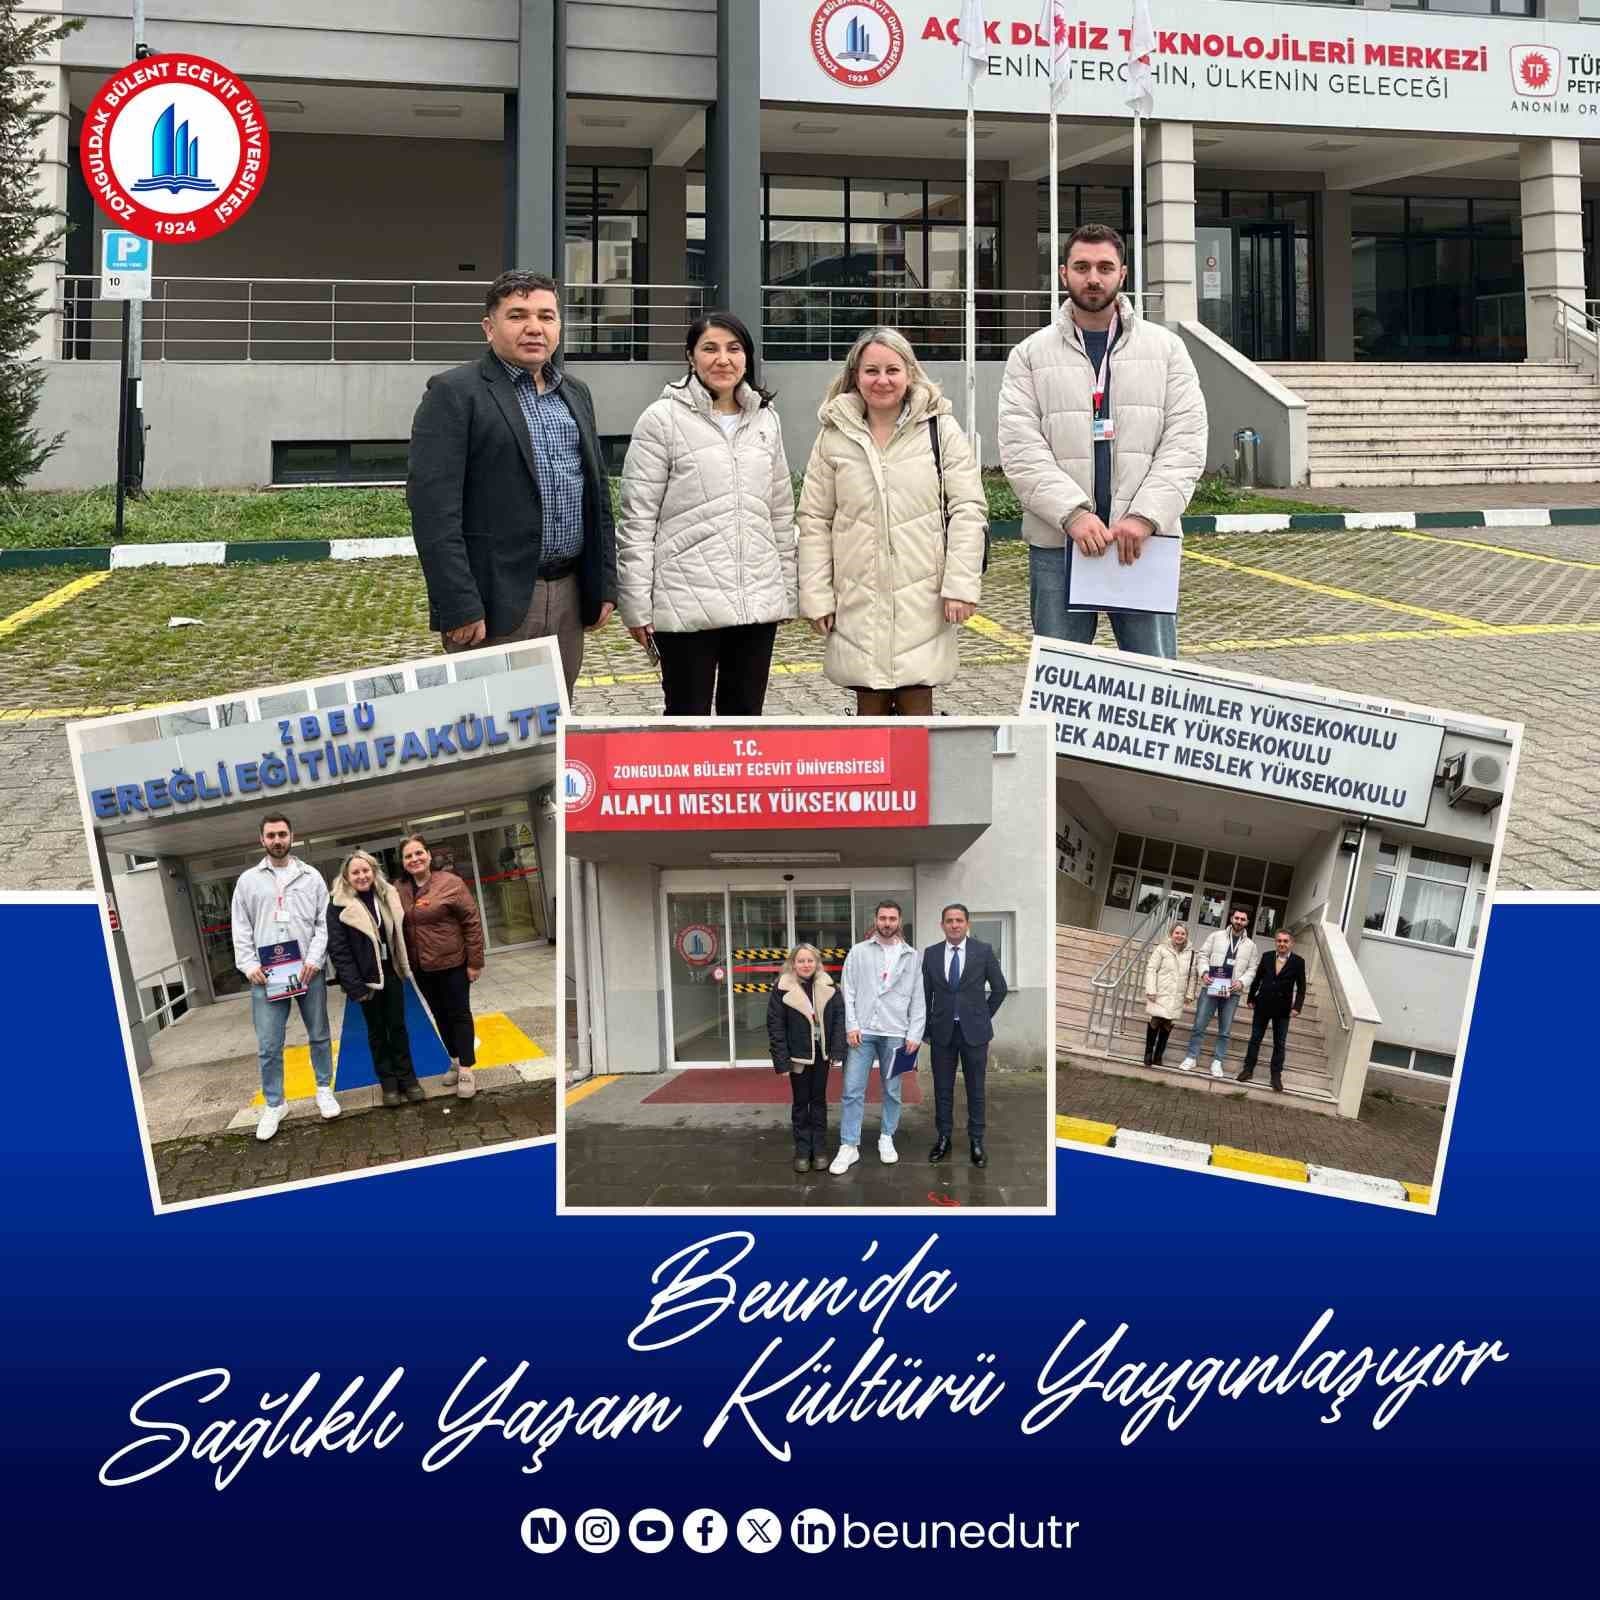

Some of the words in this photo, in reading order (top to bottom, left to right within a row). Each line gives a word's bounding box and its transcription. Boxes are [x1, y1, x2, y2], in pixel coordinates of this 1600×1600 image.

[920, 16, 1001, 46] AÇK
[1118, 29, 1355, 64] TKNOLOJİLERİ
[1364, 43, 1488, 72] MERKEZİ
[987, 53, 1051, 78] ENİN
[1206, 63, 1318, 92] ÜLKENİN
[1328, 73, 1448, 99] GELECEĞİ
[1510, 99, 1569, 113] ANONİM
[117, 237, 141, 262] P
[109, 277, 121, 287] 10
[1098, 703, 1179, 736] MESLEK
[1184, 719, 1332, 766] YÜKSEKOKULU
[1151, 684, 1244, 722] BİLİMLER
[1250, 704, 1397, 750] YÜKSEKOKULU
[732, 739, 763, 757] T.C.
[91, 760, 233, 819] EREĞLİ
[235, 739, 371, 793] EĞİTİM
[613, 763, 690, 779] ZONGULDAK
[693, 760, 743, 777] BÜLENT
[747, 760, 792, 776] ECEVİT
[796, 756, 885, 775] ÜNİVERSİTESİ
[1092, 730, 1170, 761] ADALET
[1174, 745, 1254, 780] MESLEK
[1260, 761, 1408, 808] YÜKSEKOKULU
[600, 793, 673, 816] ALAPLI
[678, 792, 763, 816] MESLEK
[767, 788, 917, 814] YÜKSEKOKULU
